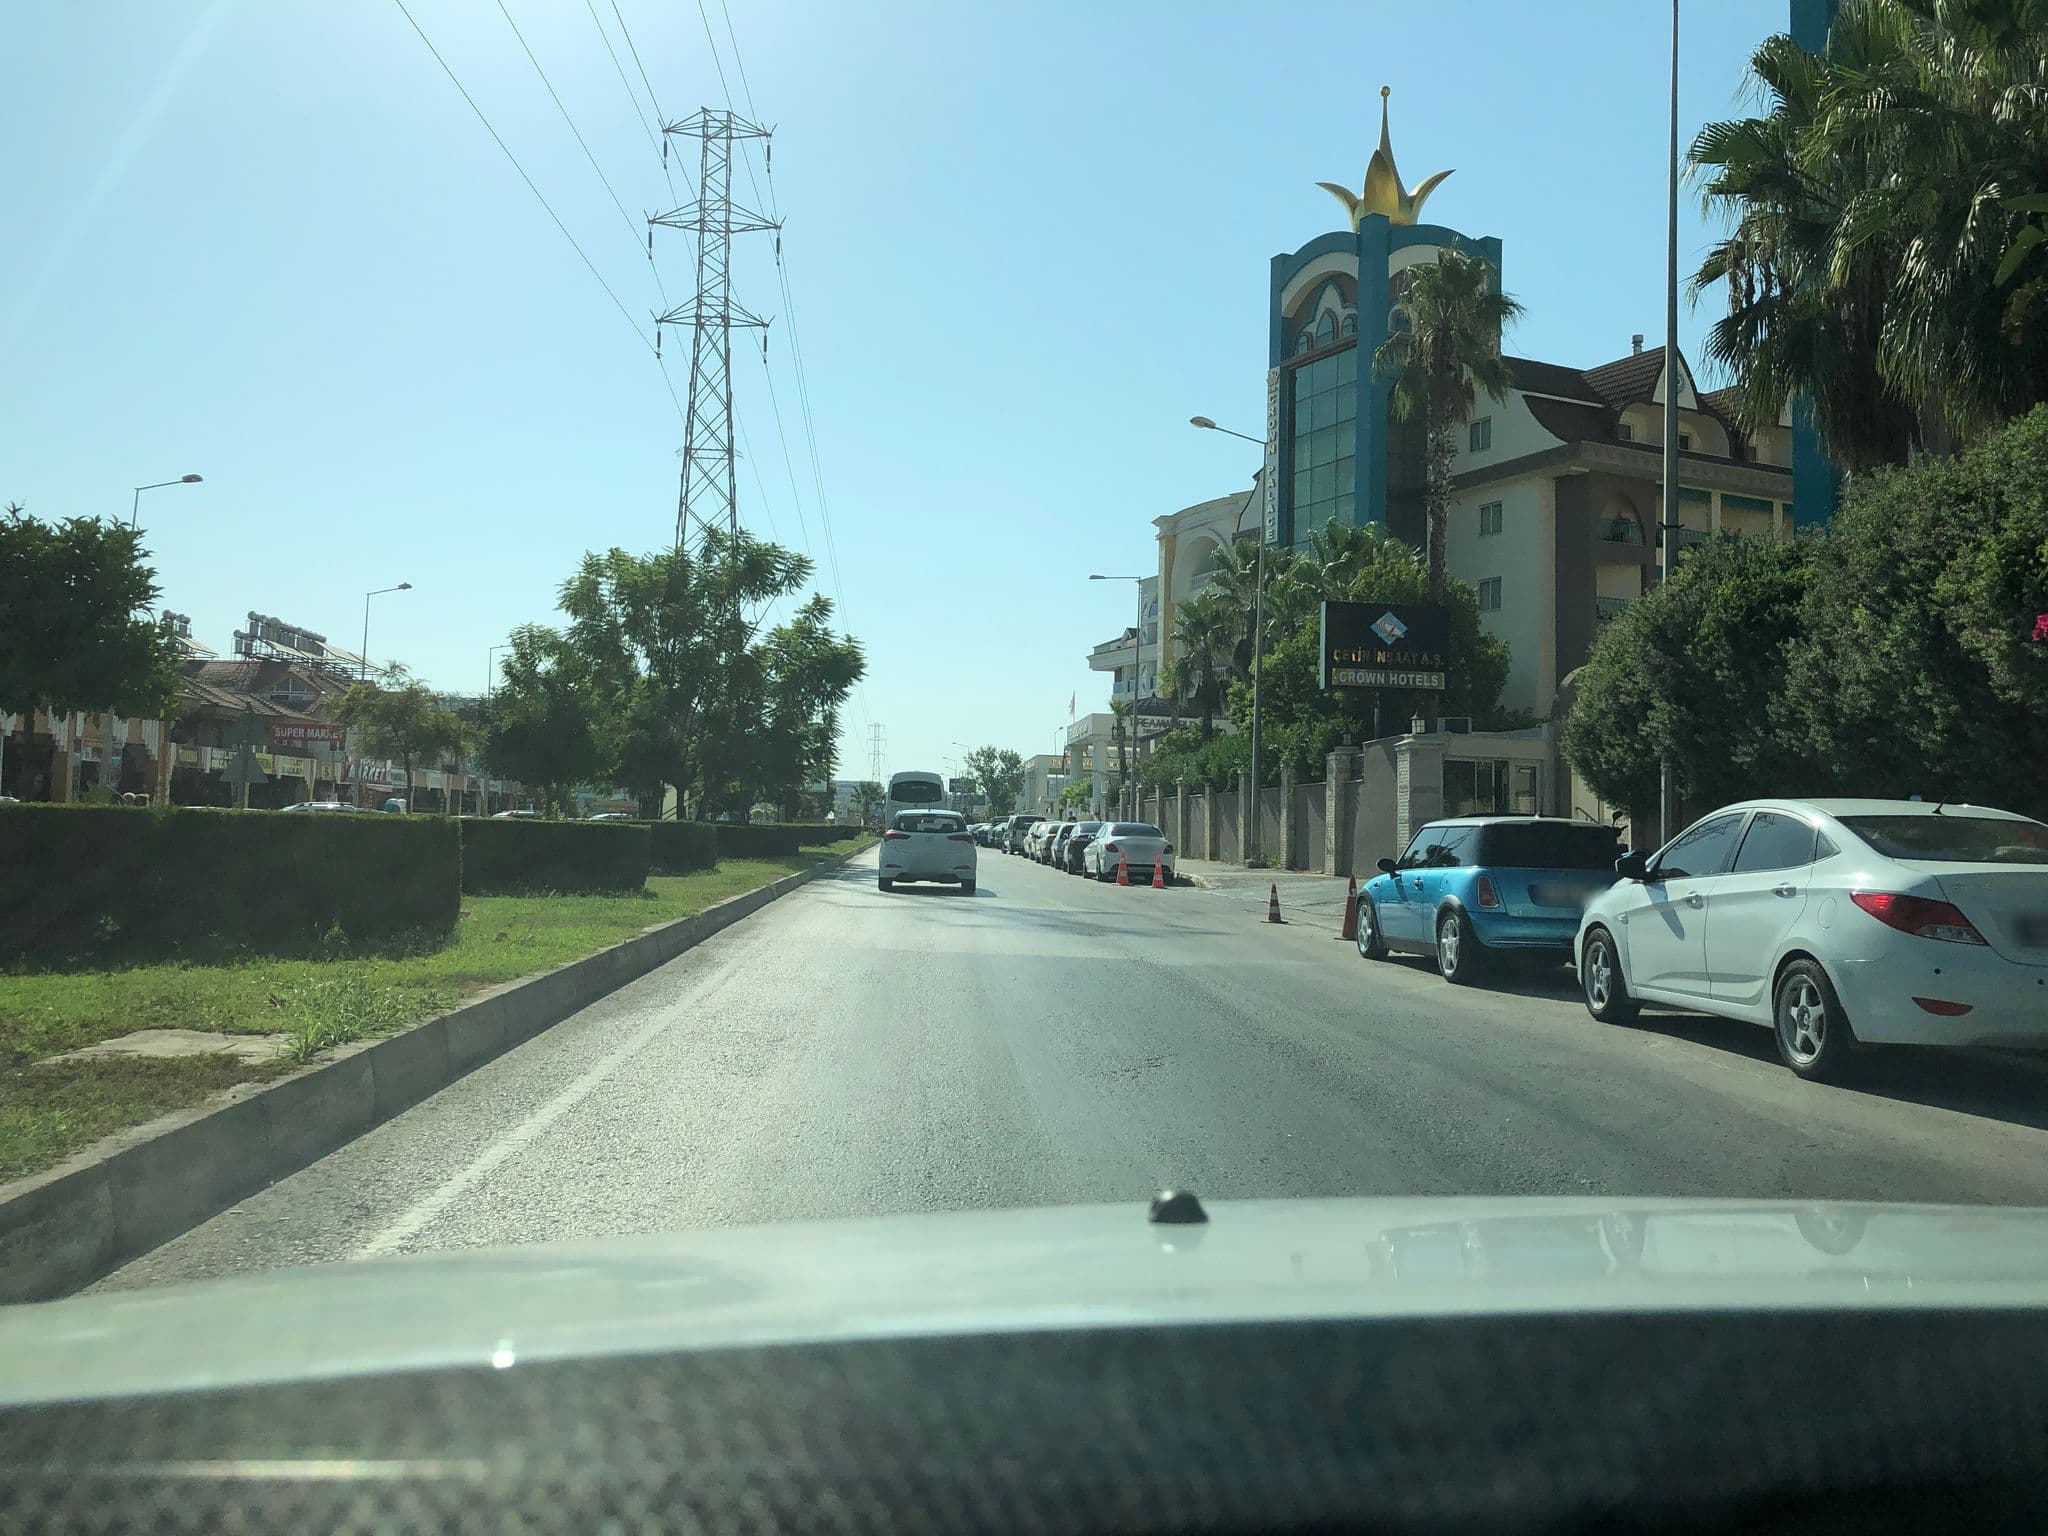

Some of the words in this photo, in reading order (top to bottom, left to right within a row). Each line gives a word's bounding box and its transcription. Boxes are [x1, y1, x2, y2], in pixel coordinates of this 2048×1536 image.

[1268, 394, 1276, 455] CROWN
[1266, 466, 1275, 539] PALACE
[1340, 672, 1385, 684] CROWN
[1390, 673, 1439, 686] HOTELS
[1130, 717, 1195, 729] REAMWRLD
[275, 727, 304, 738] SUPER
